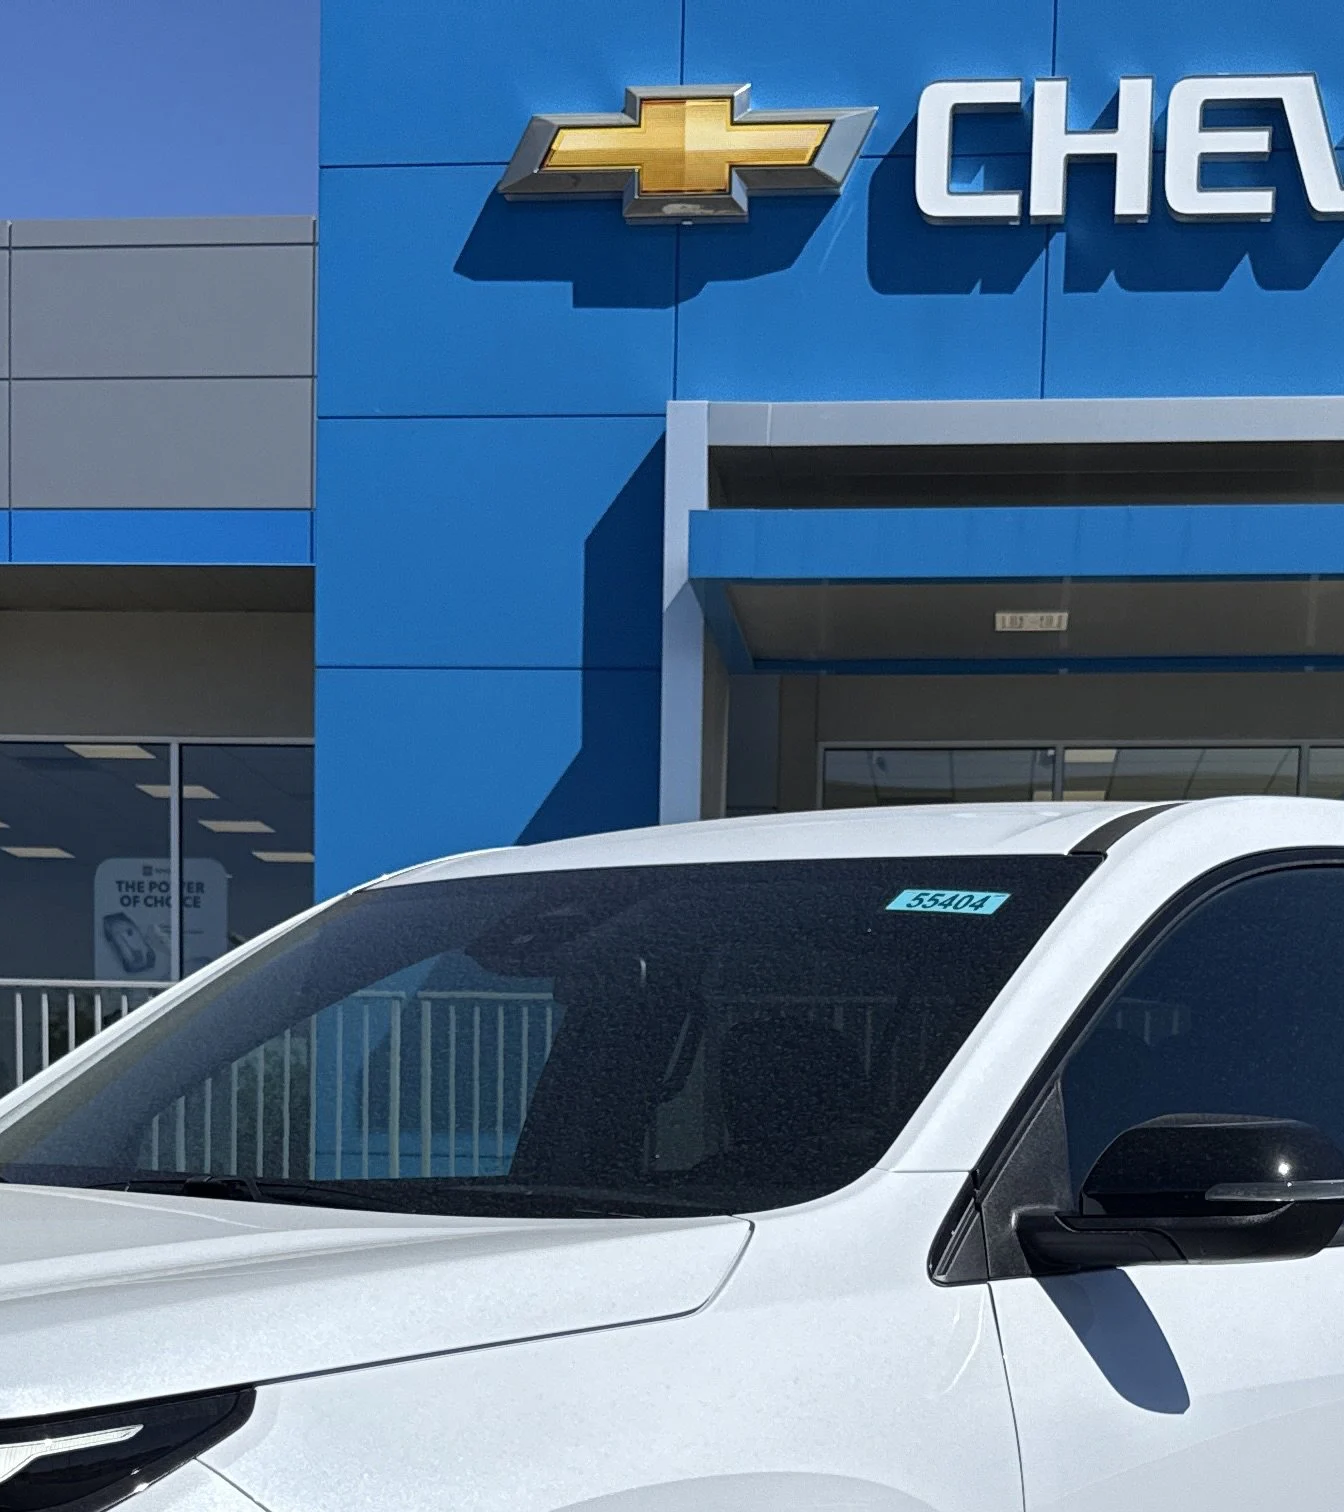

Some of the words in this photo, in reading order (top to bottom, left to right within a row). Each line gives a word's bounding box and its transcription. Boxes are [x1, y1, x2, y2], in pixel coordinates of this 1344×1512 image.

[115, 880, 145, 893] THE
[149, 880, 205, 894] POER
[120, 895, 141, 907] OF
[905, 892, 992, 911] 55404
